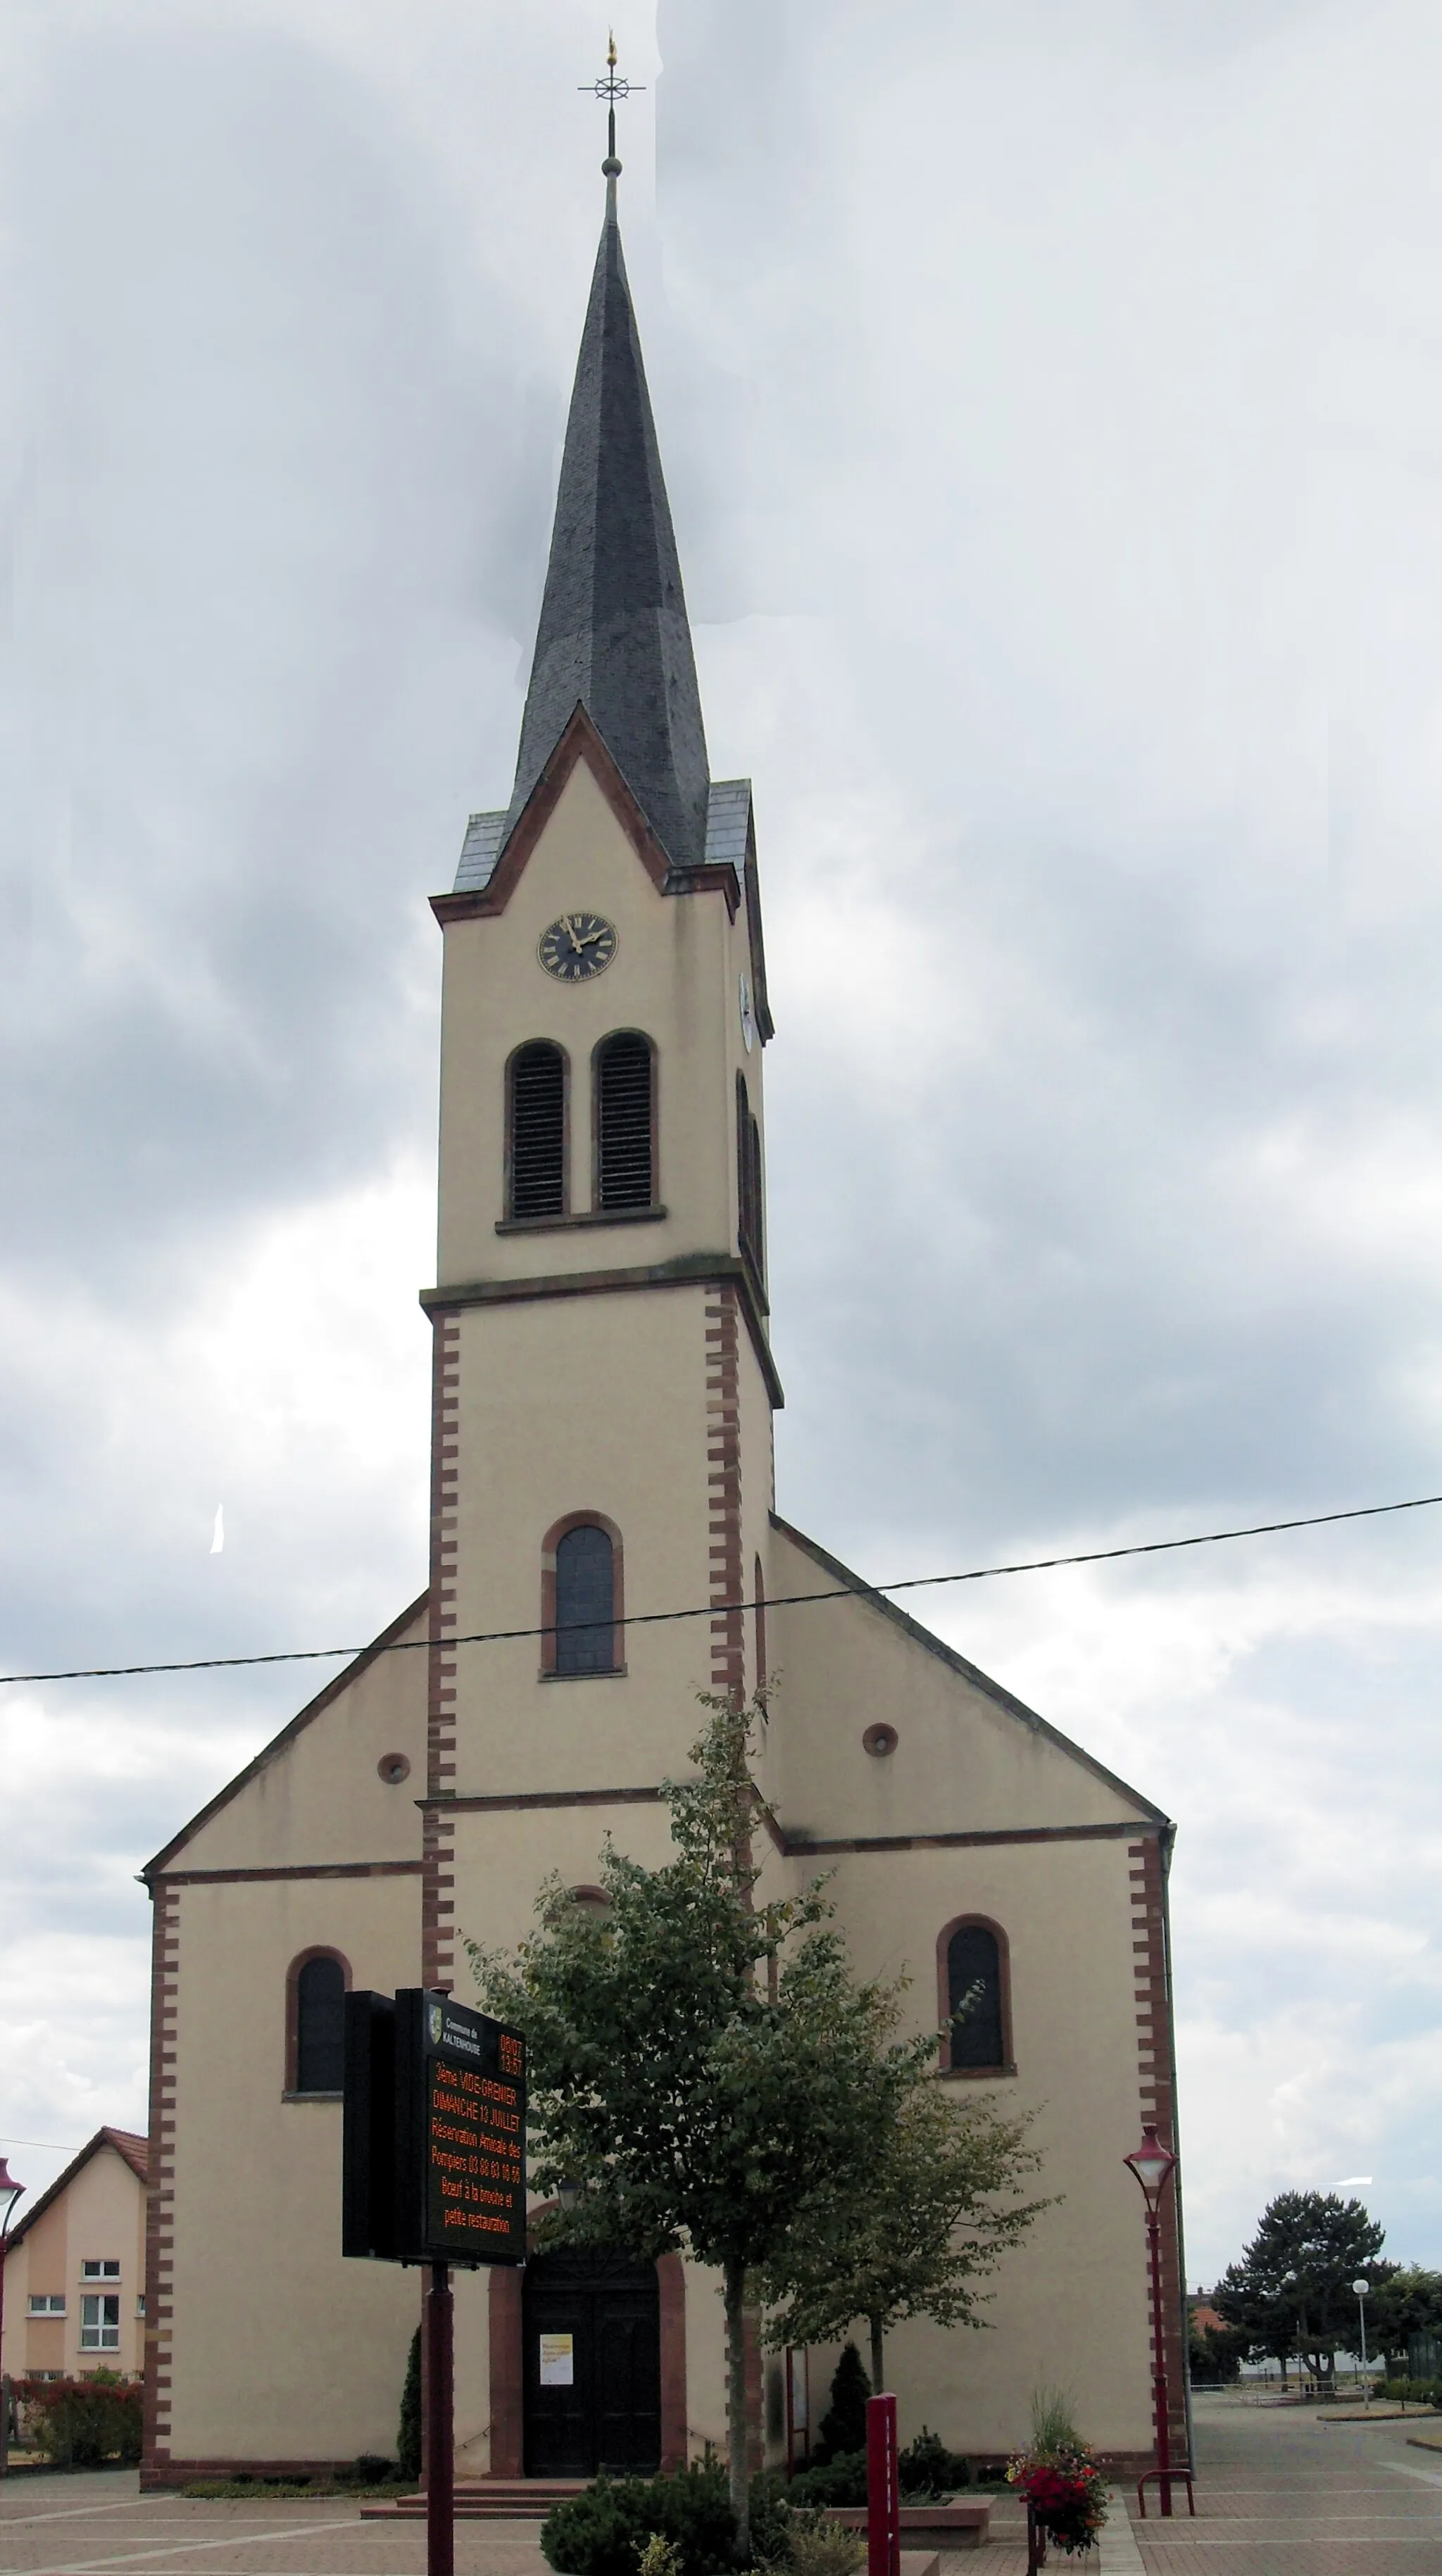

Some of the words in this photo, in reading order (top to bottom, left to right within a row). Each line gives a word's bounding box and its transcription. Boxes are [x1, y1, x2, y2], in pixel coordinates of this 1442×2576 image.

[443, 2031, 481, 2056] KALTENHOUSE
[446, 2017, 471, 2037] Commune
[471, 2028, 478, 2040] de
[433, 2088, 478, 2121] DIMANCHE
[479, 2104, 489, 2123] 13
[490, 2108, 520, 2132] JUILLET
[432, 2116, 477, 2147] Réservation
[479, 2130, 507, 2155] Amicale
[508, 2140, 520, 2159] des
[432, 2145, 467, 2173] Pompiers
[468, 2154, 478, 2174] 03
[479, 2157, 489, 2177] 88
[464, 2178, 470, 2199] à
[472, 2182, 478, 2201] la
[479, 2184, 504, 2206] broche
[506, 2193, 513, 2209] et
[444, 2206, 467, 2228] petite
[468, 2213, 510, 2233] restauration
